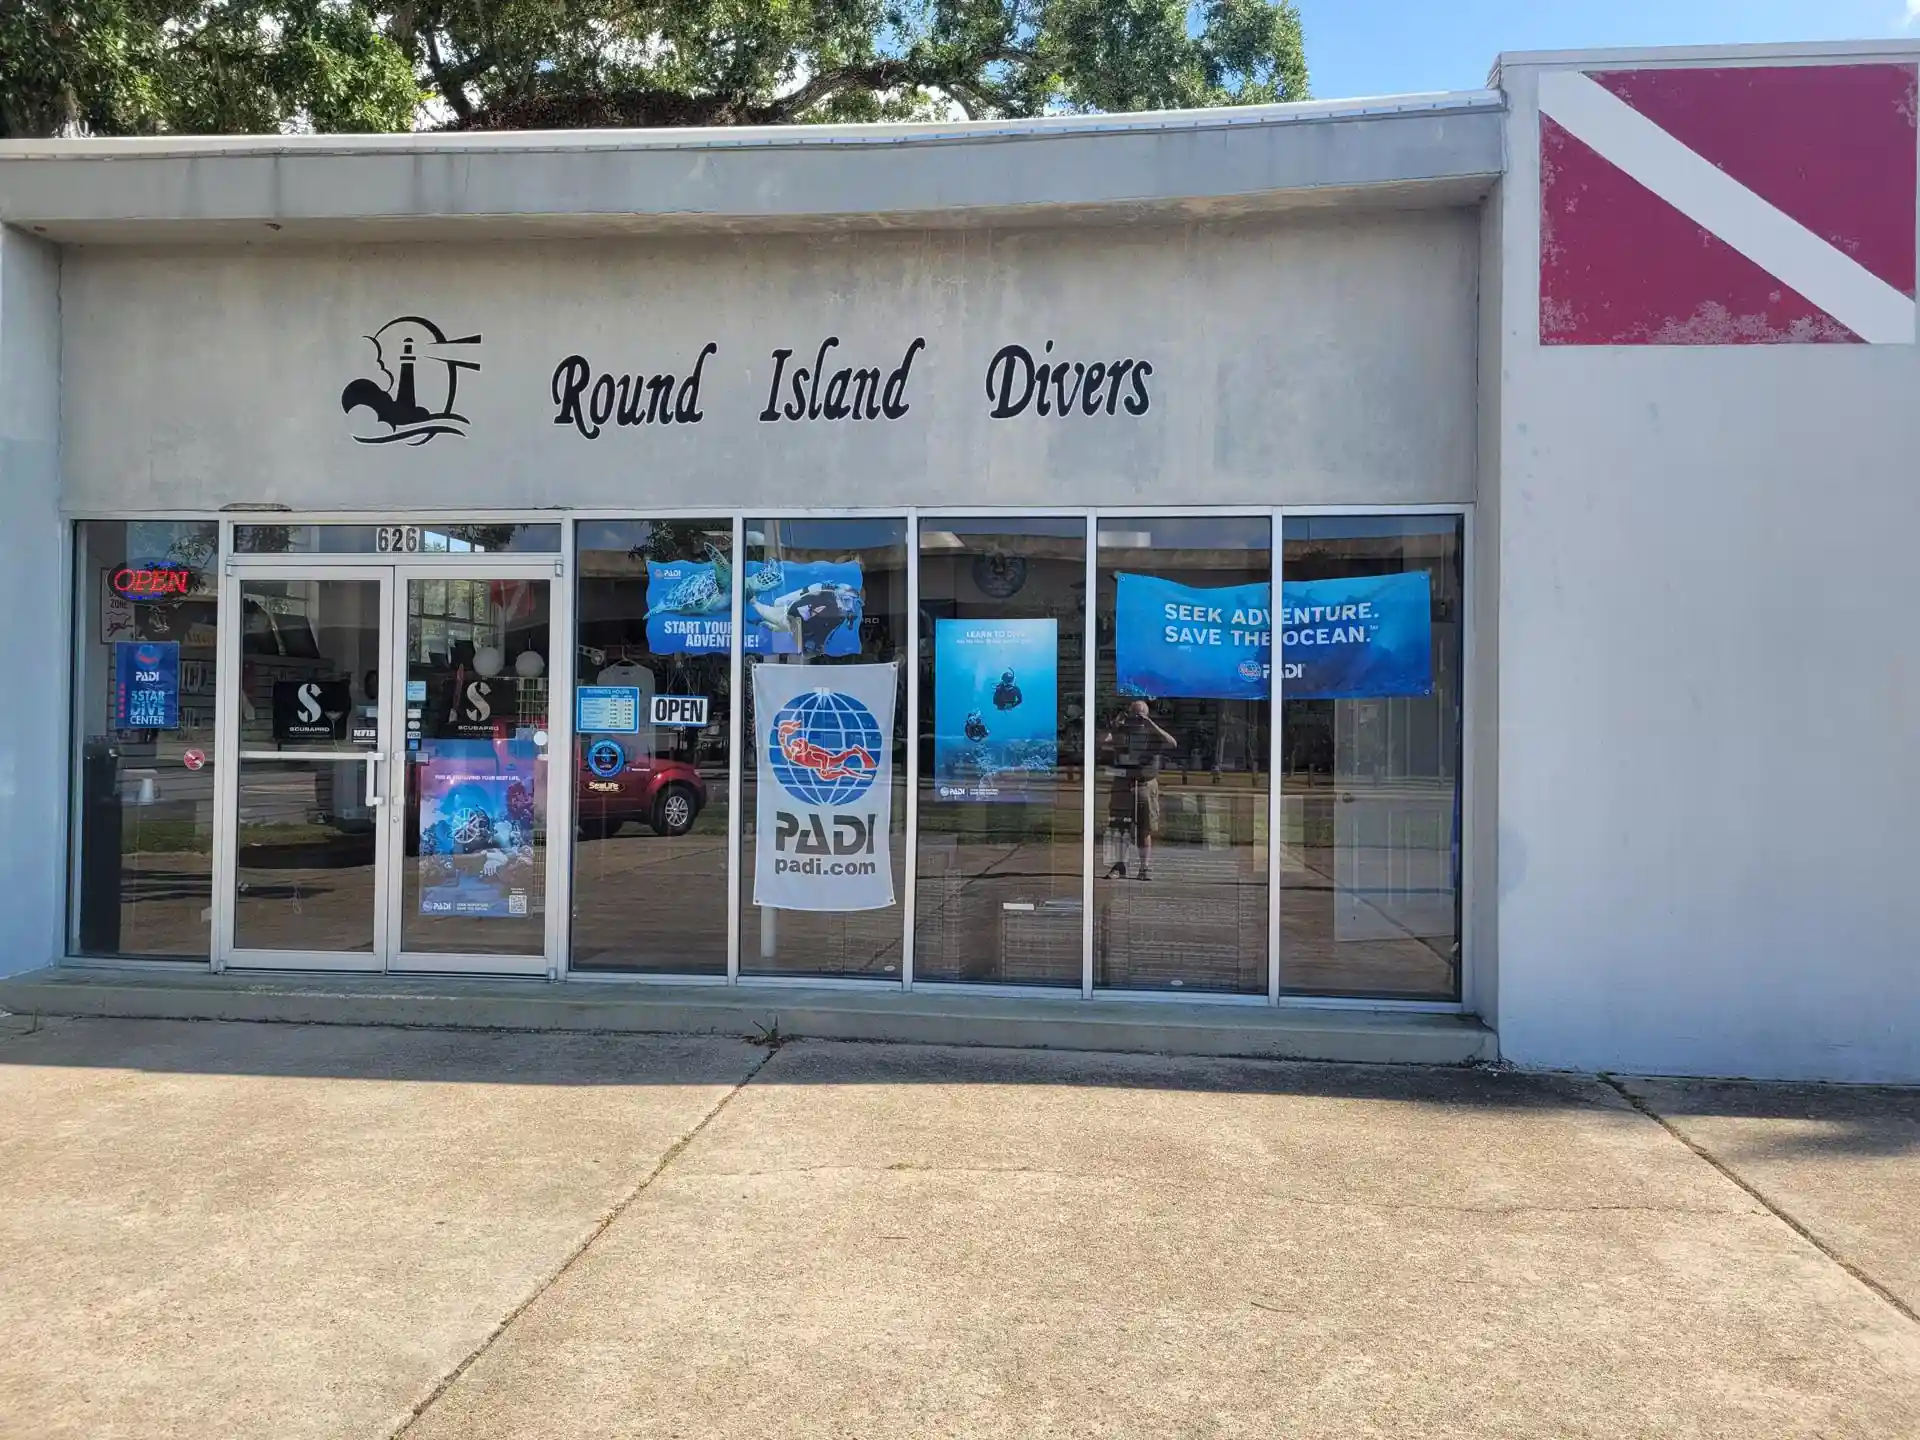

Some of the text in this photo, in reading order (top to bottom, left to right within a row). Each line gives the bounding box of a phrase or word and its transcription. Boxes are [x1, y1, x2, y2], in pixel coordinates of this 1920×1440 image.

[552, 336, 1153, 440] Round Island Divers
[378, 527, 417, 552] 626
[114, 568, 189, 592] OPEN
[1164, 603, 1223, 623] SEEK
[664, 621, 732, 634] START YOUR
[966, 630, 992, 638] LEARN
[994, 630, 1006, 638] TO
[685, 634, 760, 648] ADVENTE!
[1165, 625, 1371, 647] SAVE THE OCEAN.
[135, 671, 160, 681] PADI
[1263, 664, 1303, 679] PDI
[130, 701, 165, 716] DIVE
[655, 698, 704, 722] OPEN
[130, 716, 165, 725] CENTER
[588, 781, 620, 790] SeaLife
[775, 810, 876, 855] PADI
[775, 857, 876, 876] padi.com
[433, 902, 452, 911] PADI
